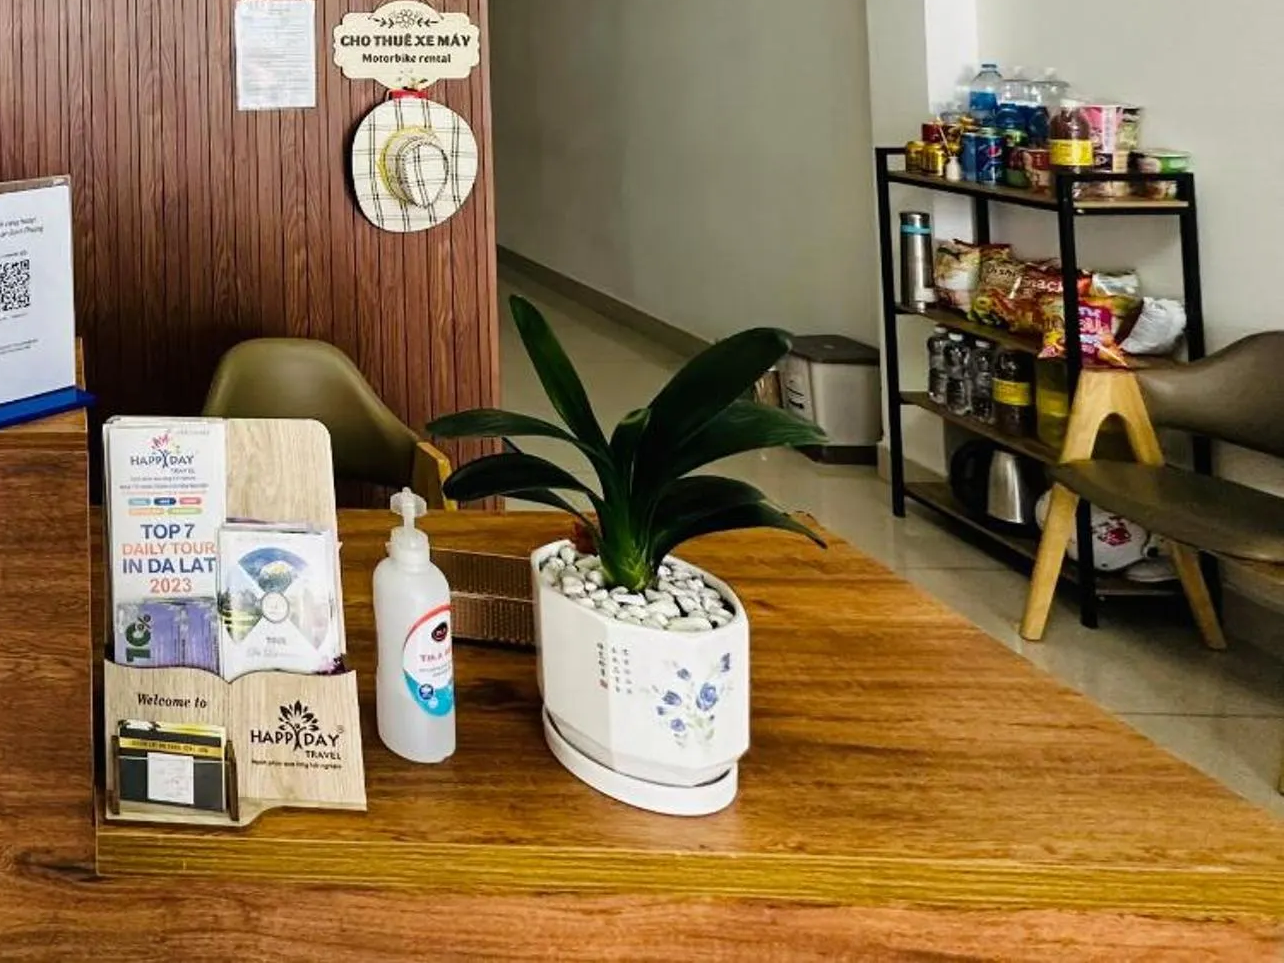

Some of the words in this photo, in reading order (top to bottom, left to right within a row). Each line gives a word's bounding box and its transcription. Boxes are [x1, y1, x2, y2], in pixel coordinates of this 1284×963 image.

[340, 34, 371, 47] CHO
[373, 32, 412, 47] THUÊ
[414, 34, 435, 47] XE
[437, 32, 471, 48] MÁY
[362, 53, 416, 64] Motorbike
[419, 53, 451, 64] rental
[170, 455, 194, 466] DAY
[140, 525, 180, 539] TOP
[185, 524, 195, 538] 7
[122, 542, 168, 556] DAILY
[170, 541, 216, 555] TOUR
[122, 559, 143, 574] IN
[148, 558, 175, 574] DA
[180, 557, 216, 573] LAT
[150, 578, 192, 593] 2023
[137, 693, 191, 709] Welcome
[194, 696, 208, 709] to
[304, 733, 340, 747] DAY
[305, 750, 342, 760] TRAVEL
